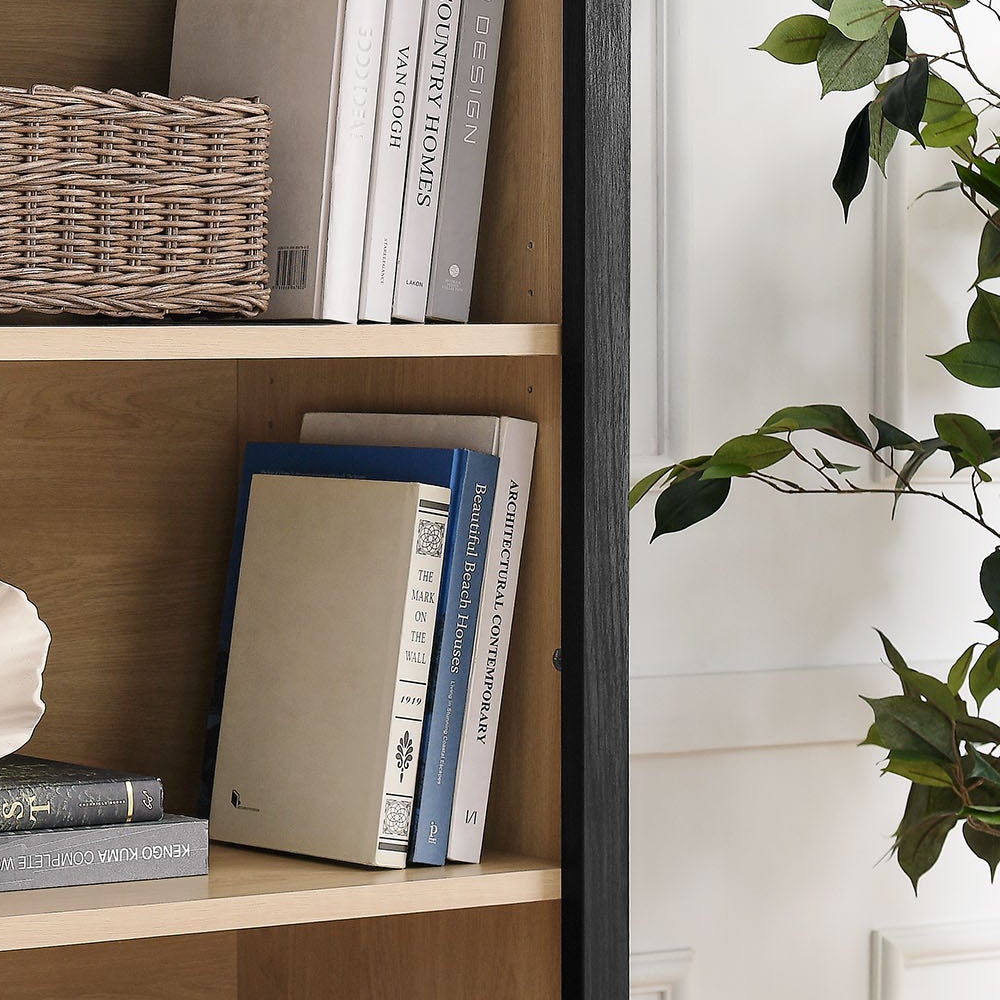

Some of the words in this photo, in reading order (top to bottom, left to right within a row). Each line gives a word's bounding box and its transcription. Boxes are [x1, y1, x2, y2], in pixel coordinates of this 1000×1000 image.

[396, 45, 410, 87] VAN
[463, 16, 489, 144] DESIGN
[389, 90, 406, 149] GOGH
[416, 113, 441, 209] HOMES
[466, 482, 487, 558] Beautiful
[493, 479, 519, 611] ARCHITECTURAL
[418, 569, 434, 583] THE
[459, 561, 477, 610] Beach
[411, 589, 435, 604] MARK
[414, 611, 428, 623] ON
[411, 631, 427, 644] THE
[450, 613, 469, 674] Houses
[405, 650, 427, 665] WALL
[447, 680, 455, 699] Living
[476, 614, 503, 745] CONTEMPORARY
[400, 695, 422, 706] 1919
[18, 850, 94, 870] COMPLETE
[98, 848, 138, 863] KUMA
[142, 843, 190, 859] KENGO
